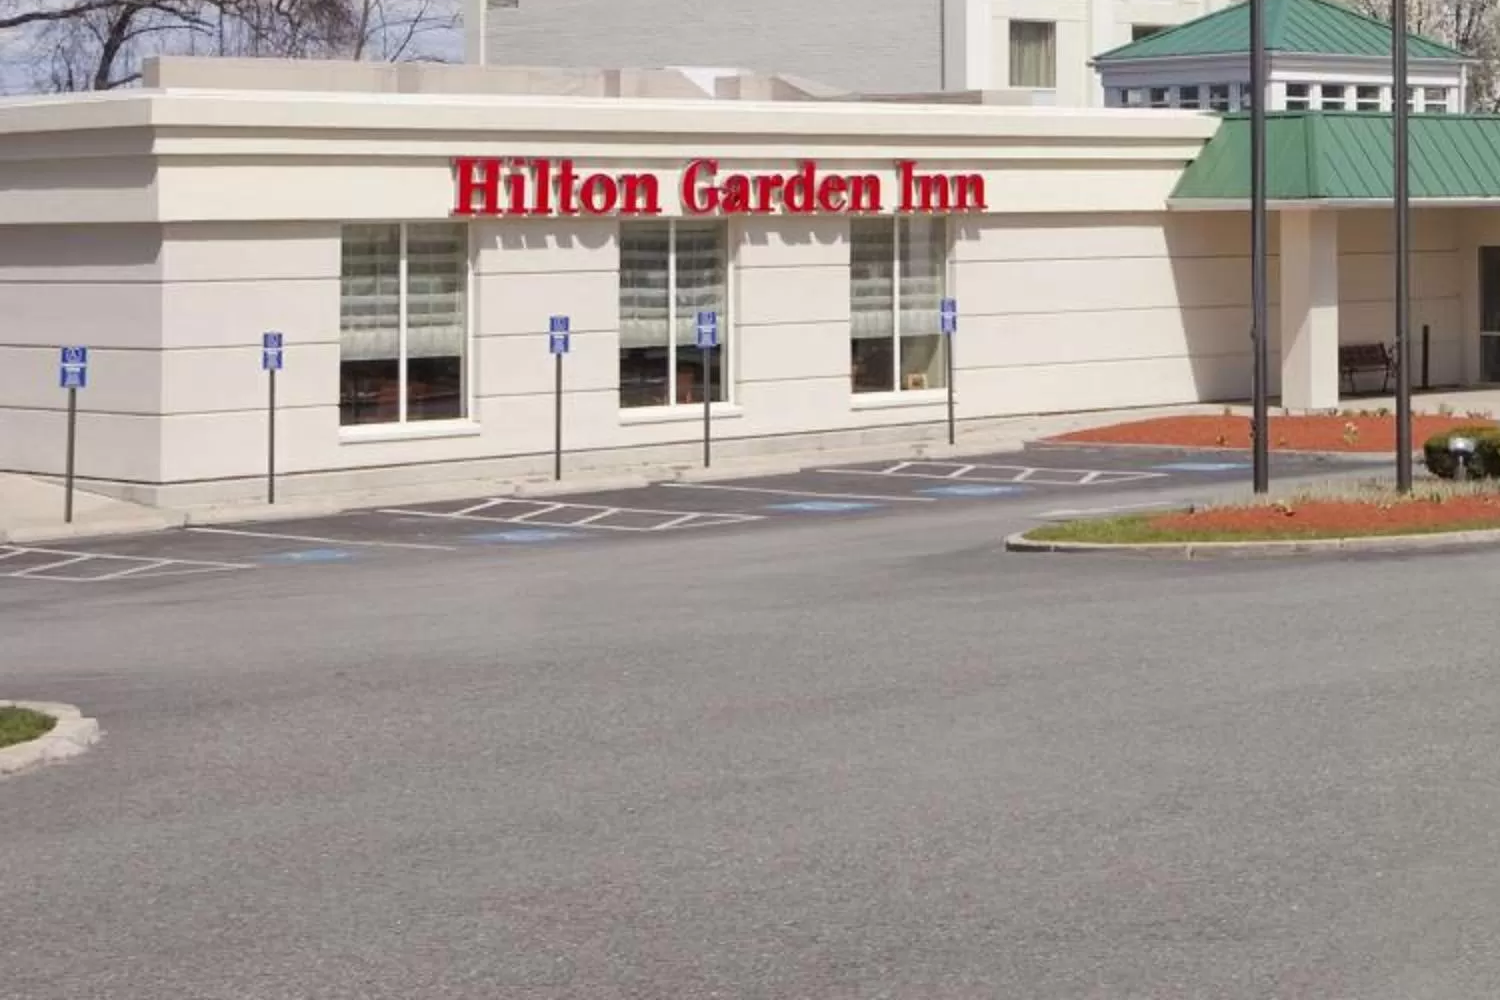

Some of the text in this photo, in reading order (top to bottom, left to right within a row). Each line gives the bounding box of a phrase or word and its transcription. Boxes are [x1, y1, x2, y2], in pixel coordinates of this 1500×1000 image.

[453, 157, 989, 215] Hilton Garden Inn
